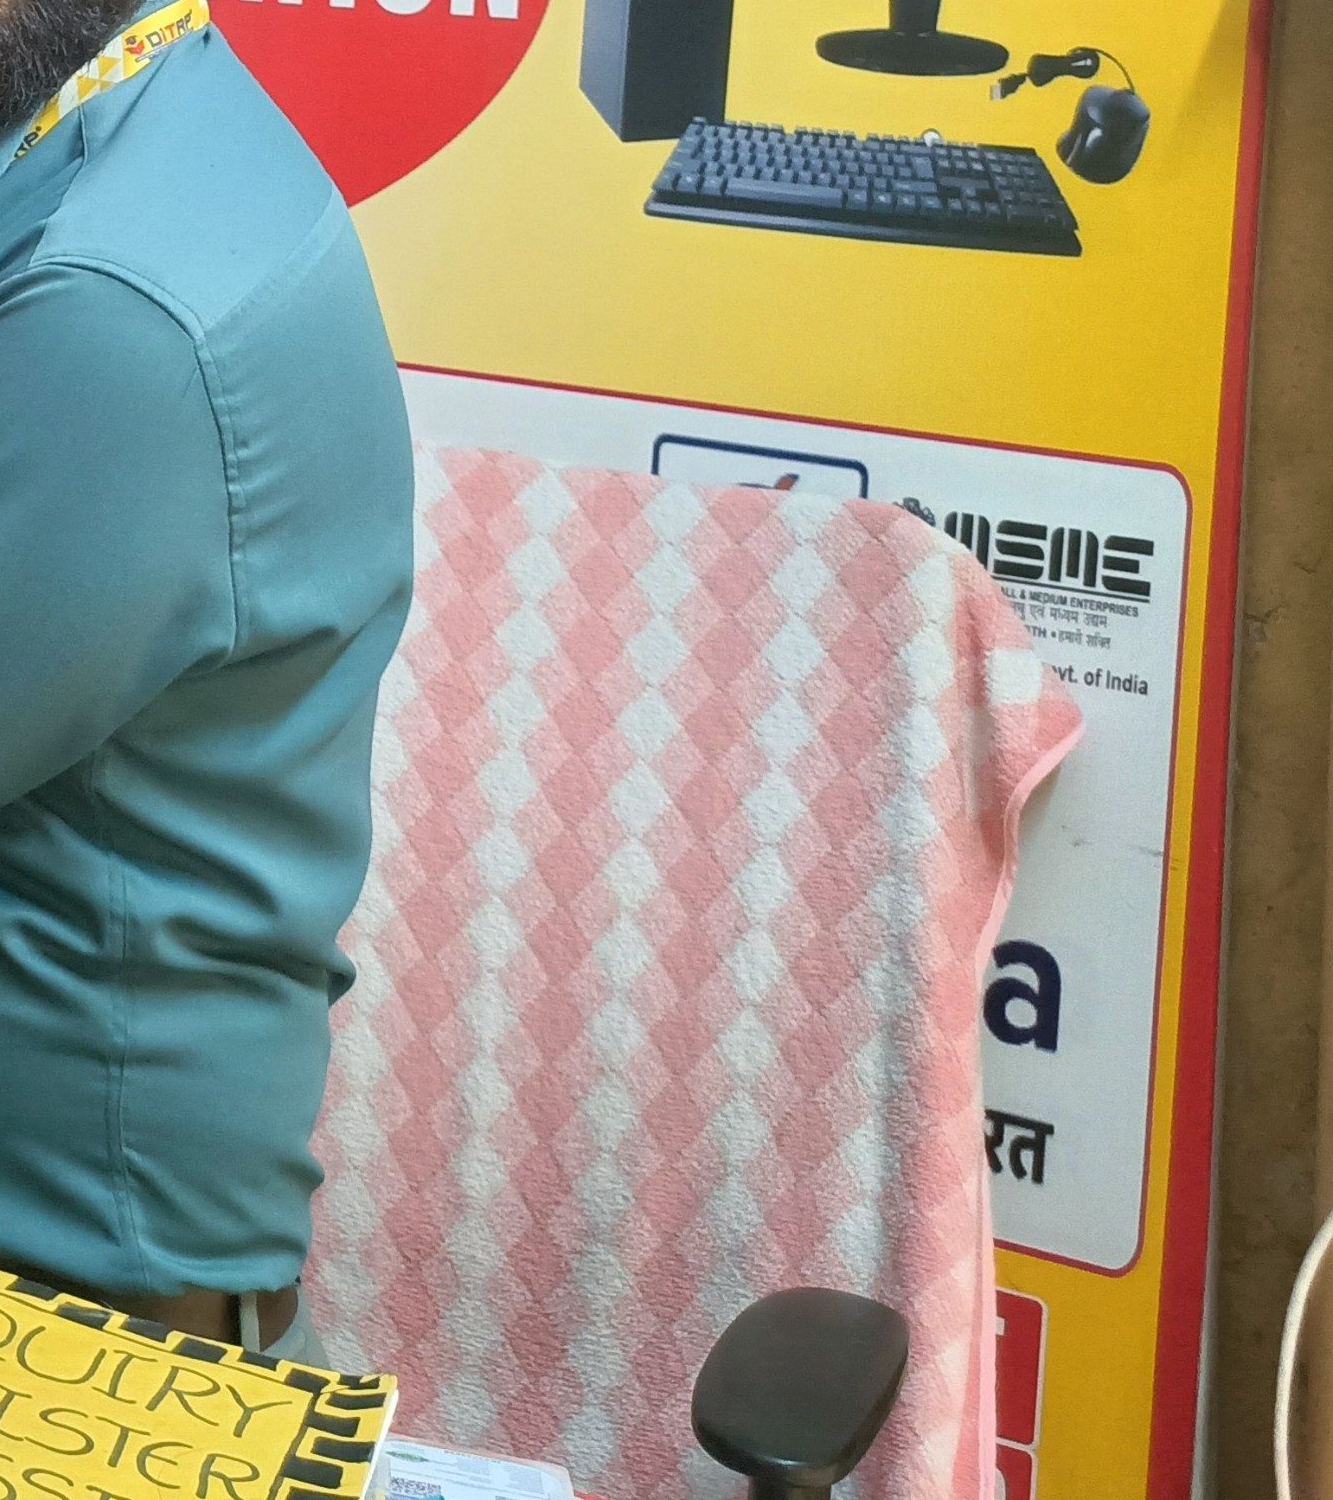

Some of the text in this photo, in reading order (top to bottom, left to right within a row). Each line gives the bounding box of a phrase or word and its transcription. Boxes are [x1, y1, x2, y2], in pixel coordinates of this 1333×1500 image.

[1070, 597, 1139, 618] ENTERPRISES
[1084, 667, 1102, 688] of
[1106, 670, 1149, 696] India
